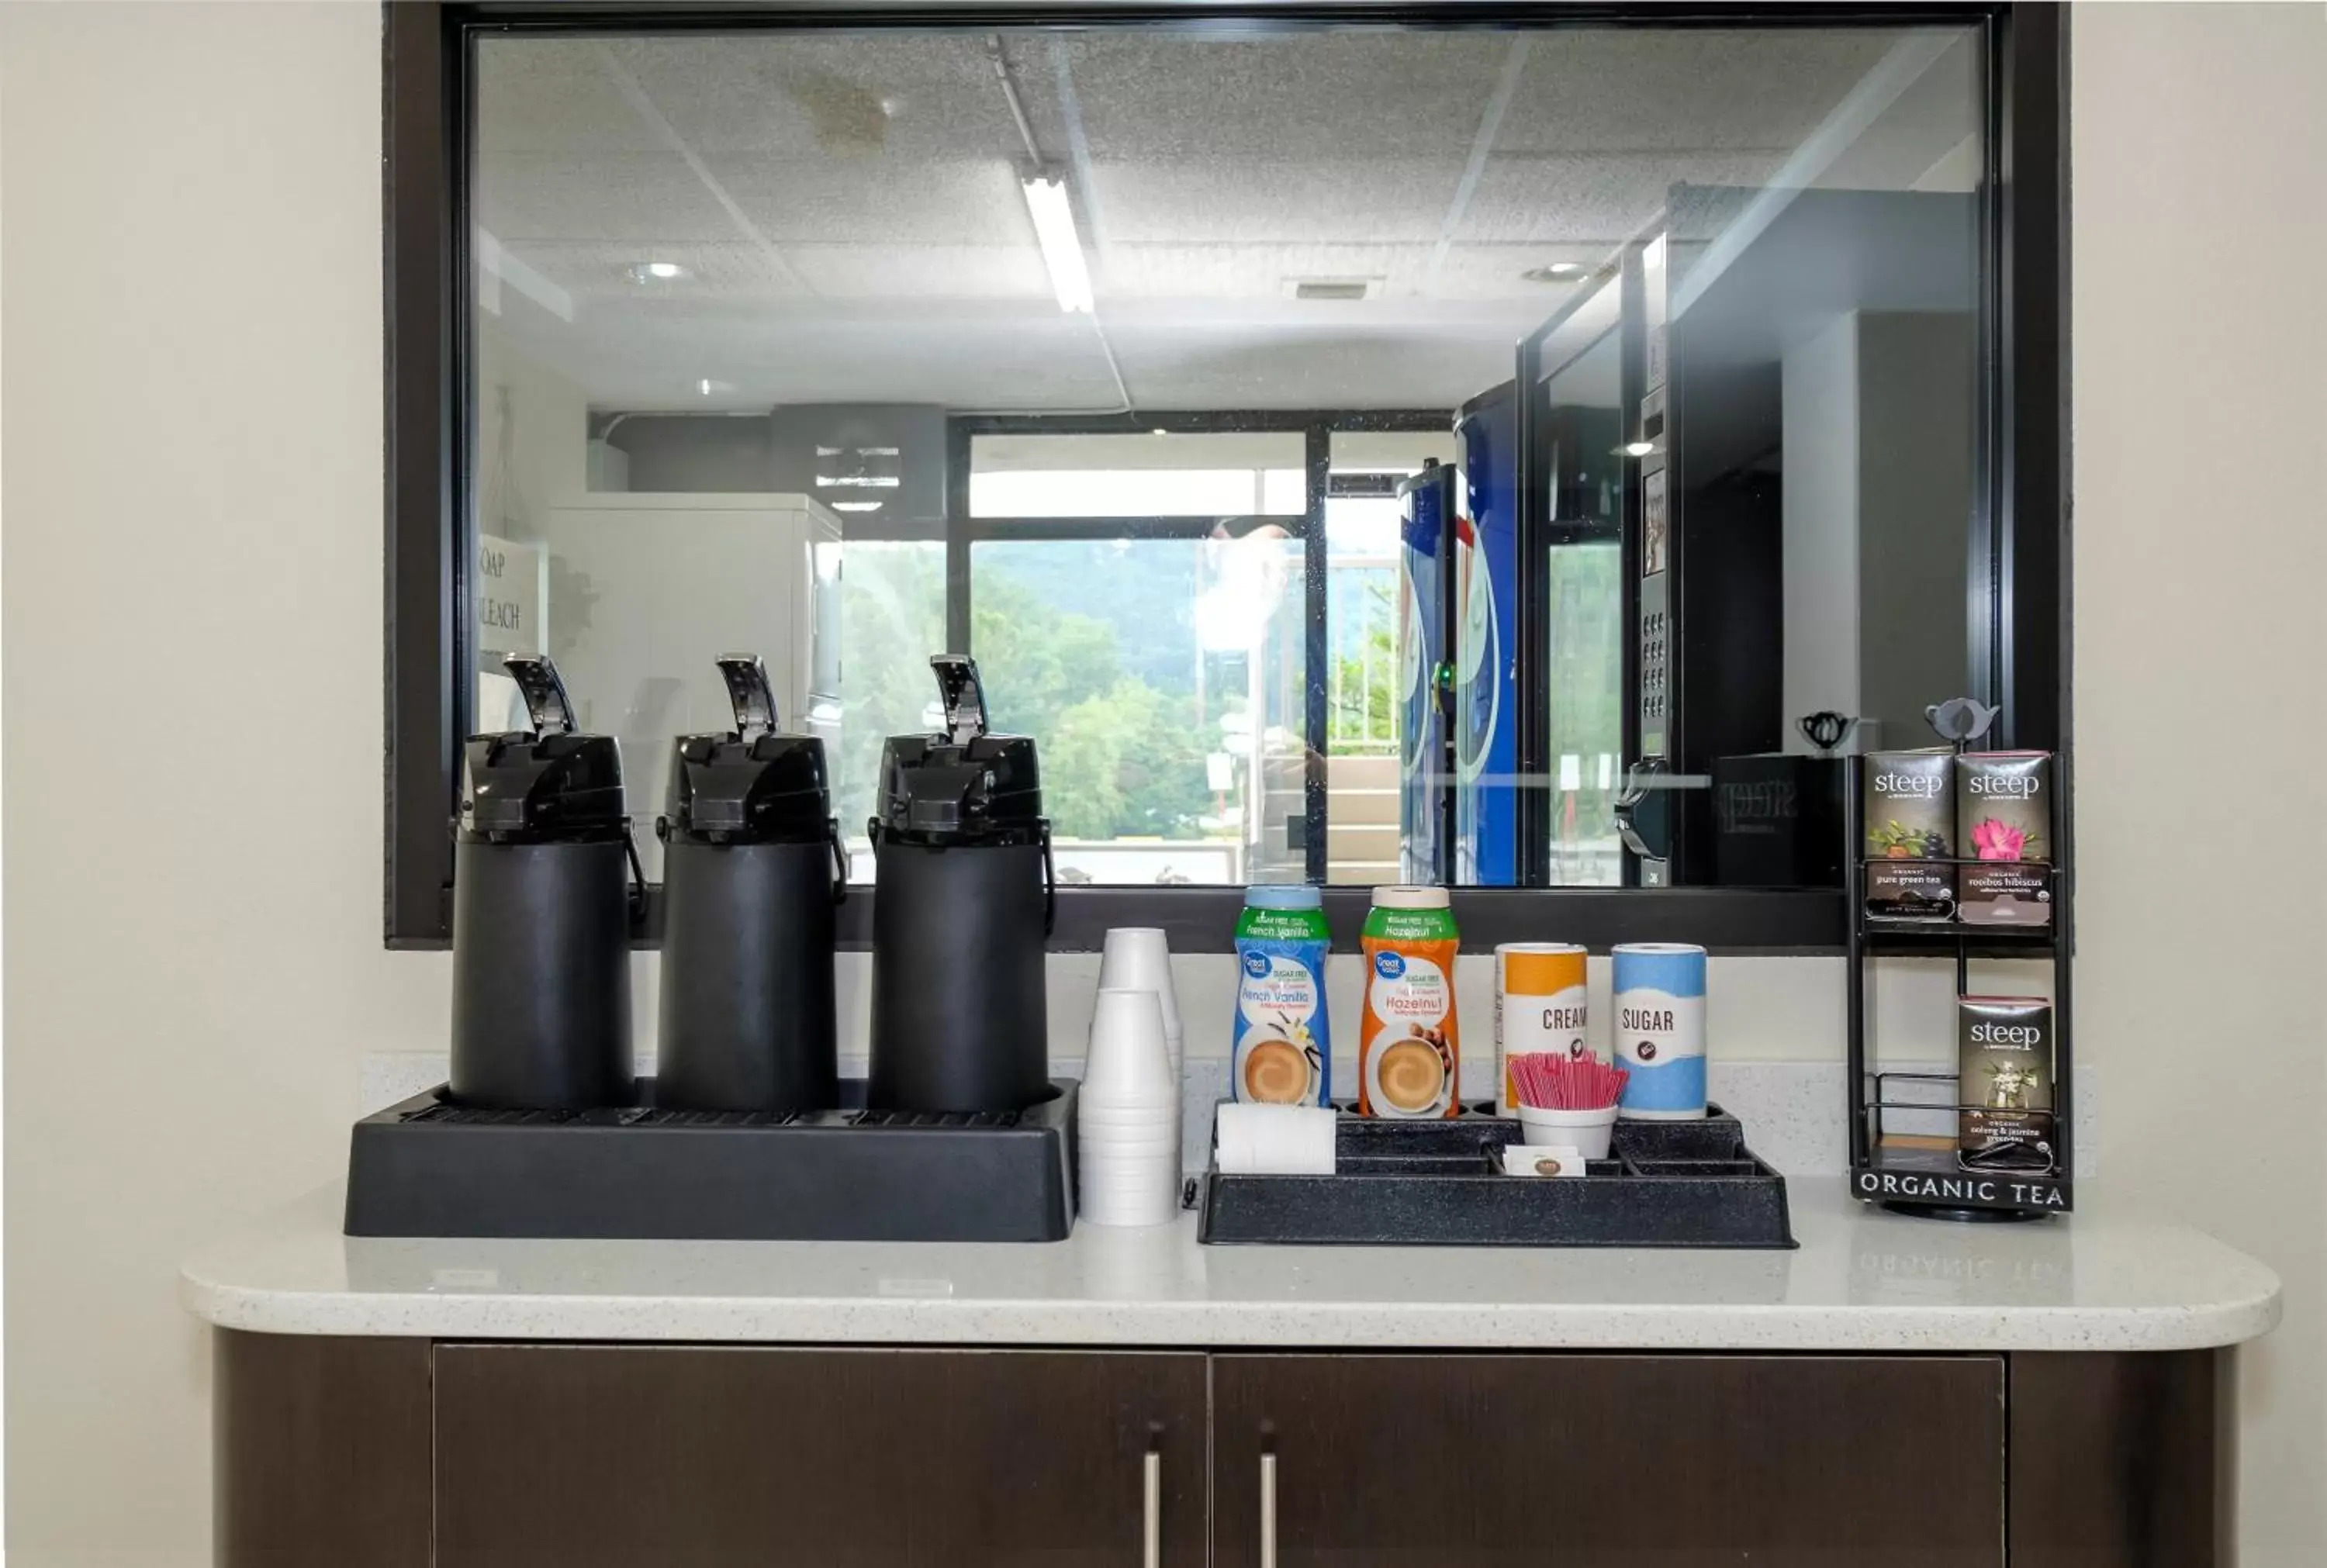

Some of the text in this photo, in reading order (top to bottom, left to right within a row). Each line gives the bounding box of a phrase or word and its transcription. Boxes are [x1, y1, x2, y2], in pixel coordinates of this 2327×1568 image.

[481, 547, 506, 578] OAP
[478, 597, 520, 630] LEACH
[1874, 770, 1944, 799] steep
[1969, 773, 2040, 800] steep
[1899, 876, 1924, 886] green
[2005, 877, 2043, 886] hibiscus
[1377, 955, 1399, 969] Great
[1274, 991, 1309, 1003] Vanilla
[1386, 996, 1443, 1009] Hazelnut
[1623, 1008, 1675, 1031] SUGAR
[1970, 1020, 2042, 1052] steep
[1860, 1173, 2064, 1206] ORGANIC TEA
